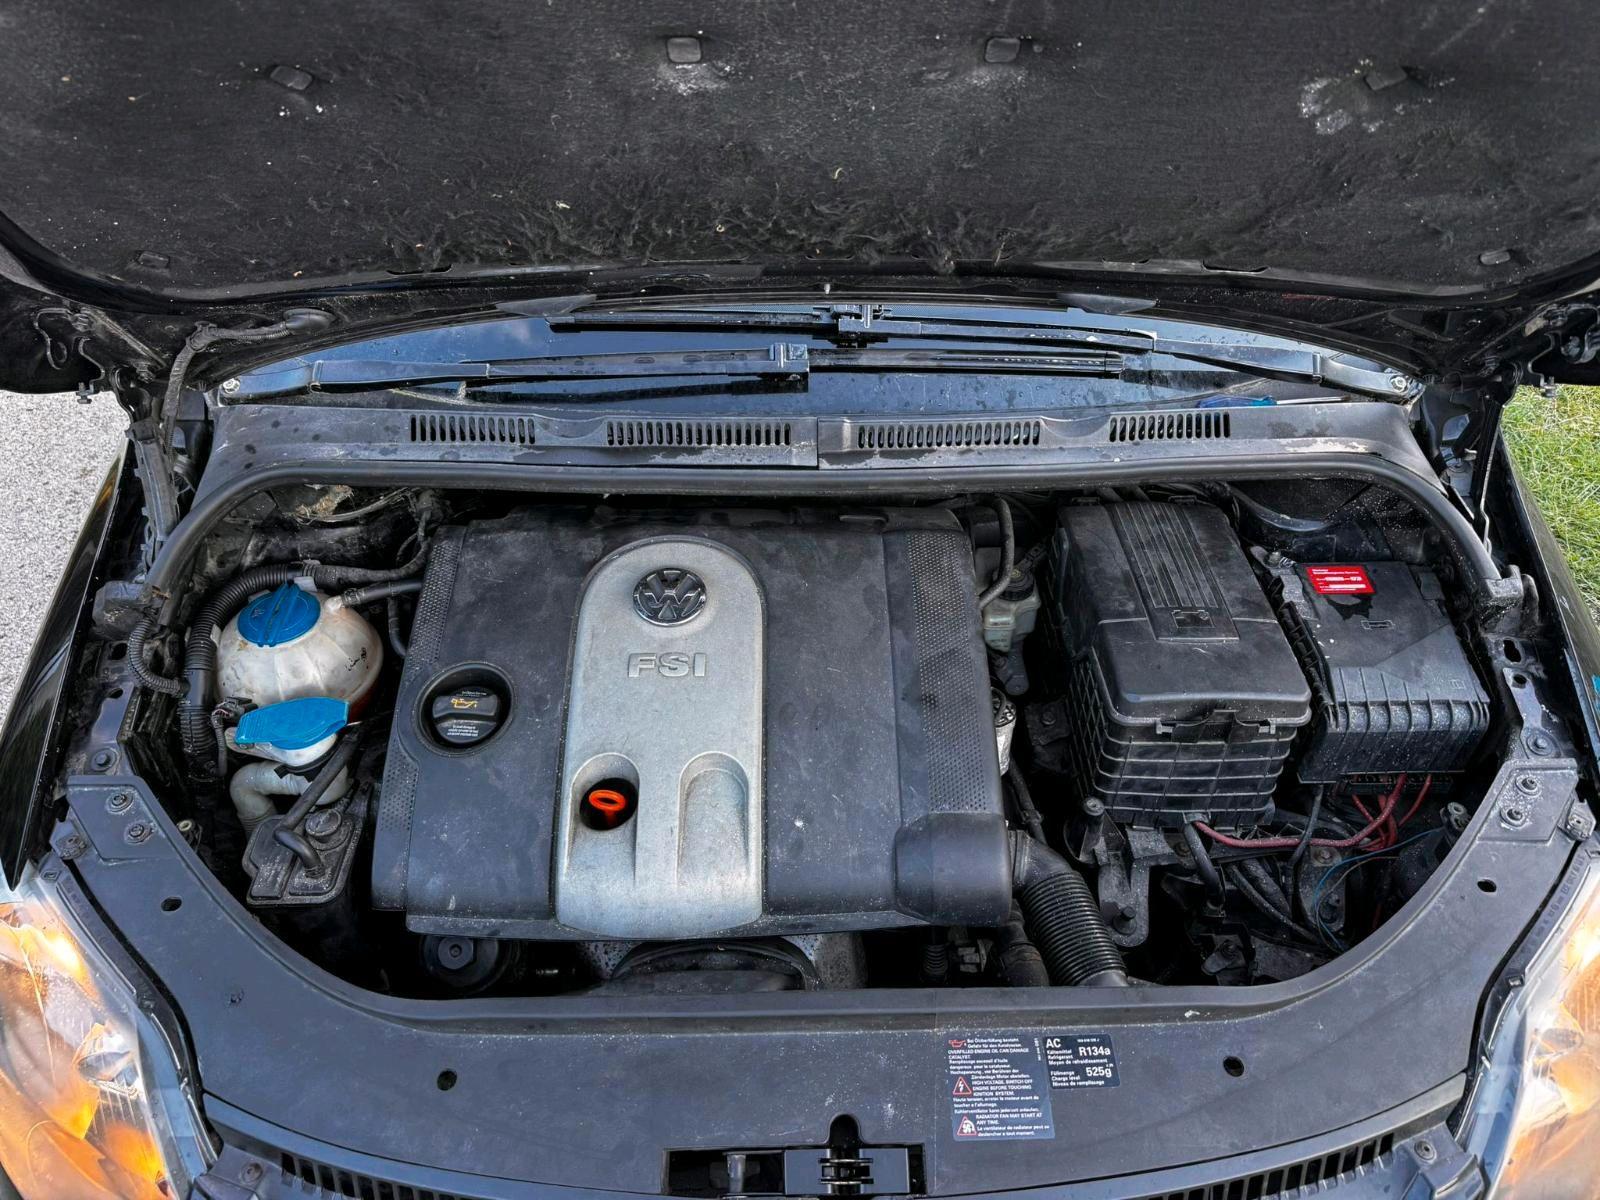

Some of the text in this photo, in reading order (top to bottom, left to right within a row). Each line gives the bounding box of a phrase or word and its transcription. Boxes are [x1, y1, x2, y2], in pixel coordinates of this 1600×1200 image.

[628, 652, 706, 677] FSI
[1046, 1038, 1061, 1048] AC
[1078, 1046, 1110, 1056] R134a
[1086, 1067, 1112, 1078] 525g
